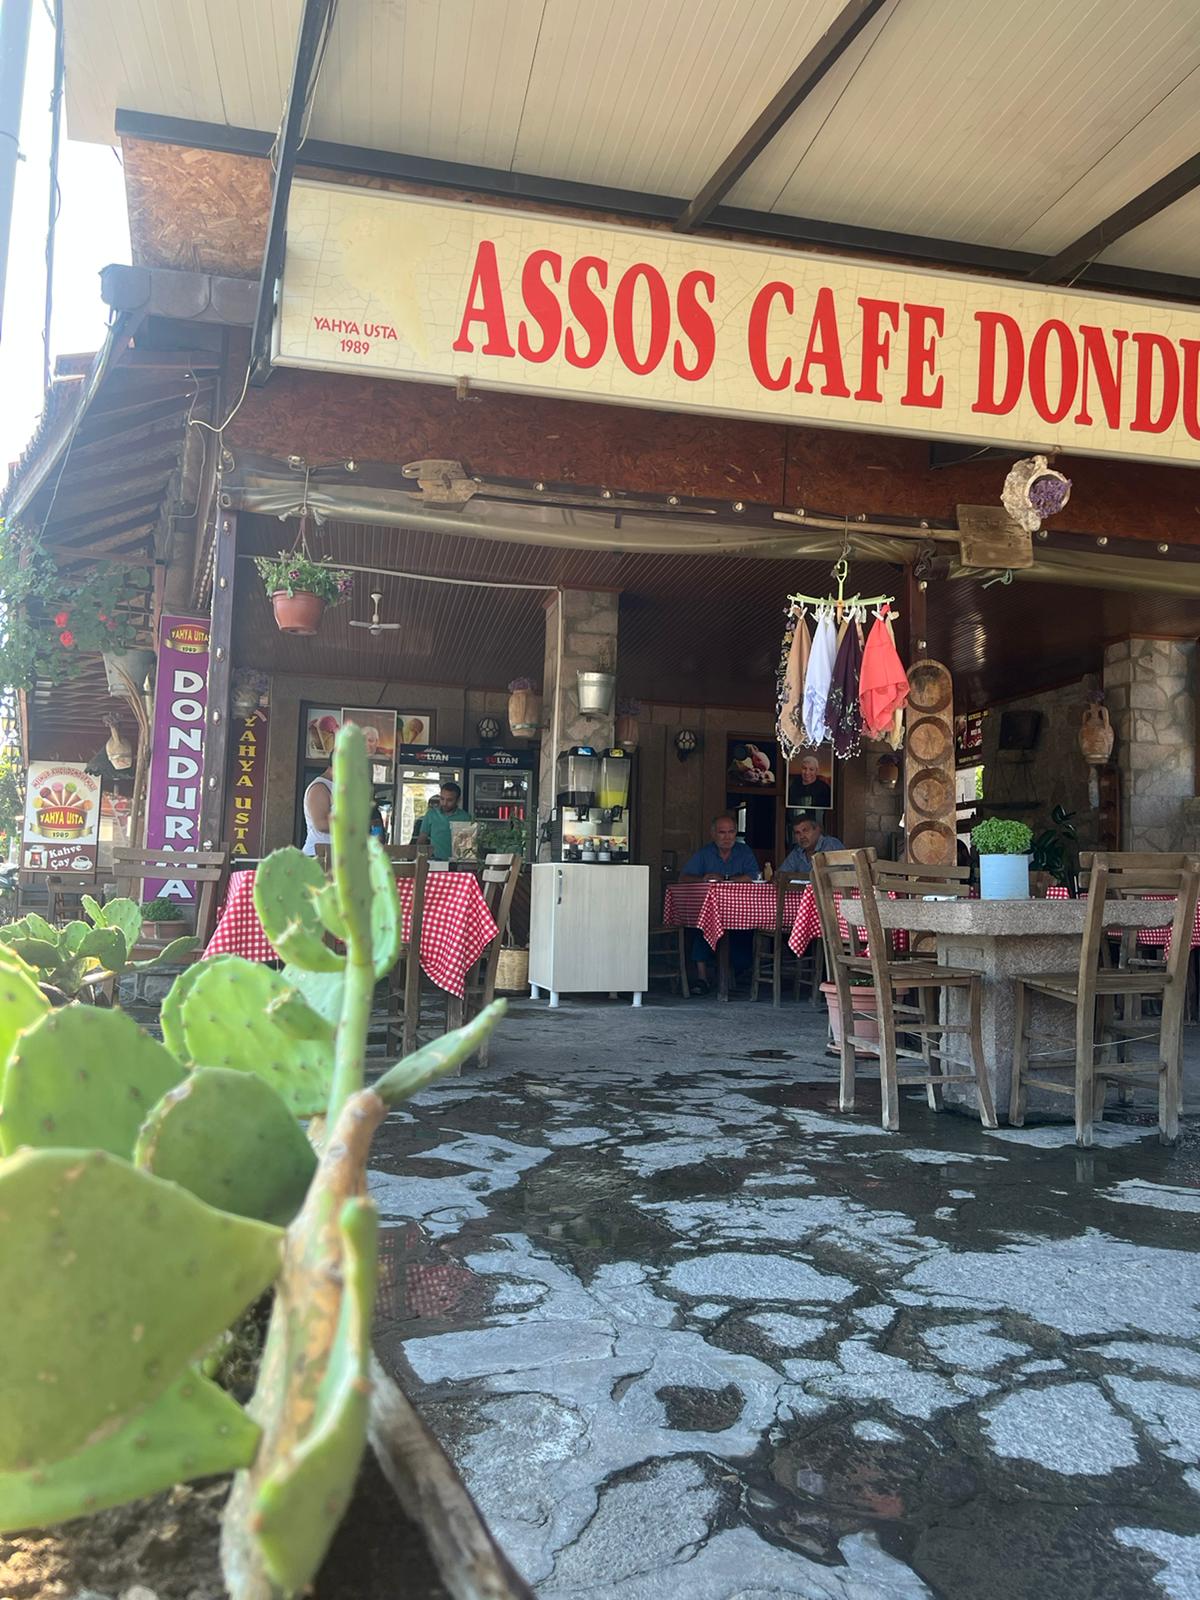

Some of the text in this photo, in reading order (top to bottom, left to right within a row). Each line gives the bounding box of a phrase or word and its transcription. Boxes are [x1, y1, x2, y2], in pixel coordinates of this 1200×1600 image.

[314, 316, 397, 340] YAHYA USTA
[453, 240, 717, 382] ASSOS
[747, 280, 946, 410] CAFE
[340, 339, 370, 354] 1989
[231, 715, 257, 855] YAHYA USTA
[40, 811, 84, 825] YAHYA USTA
[49, 845, 82, 859] Kahve
[51, 858, 70, 871] Çay
